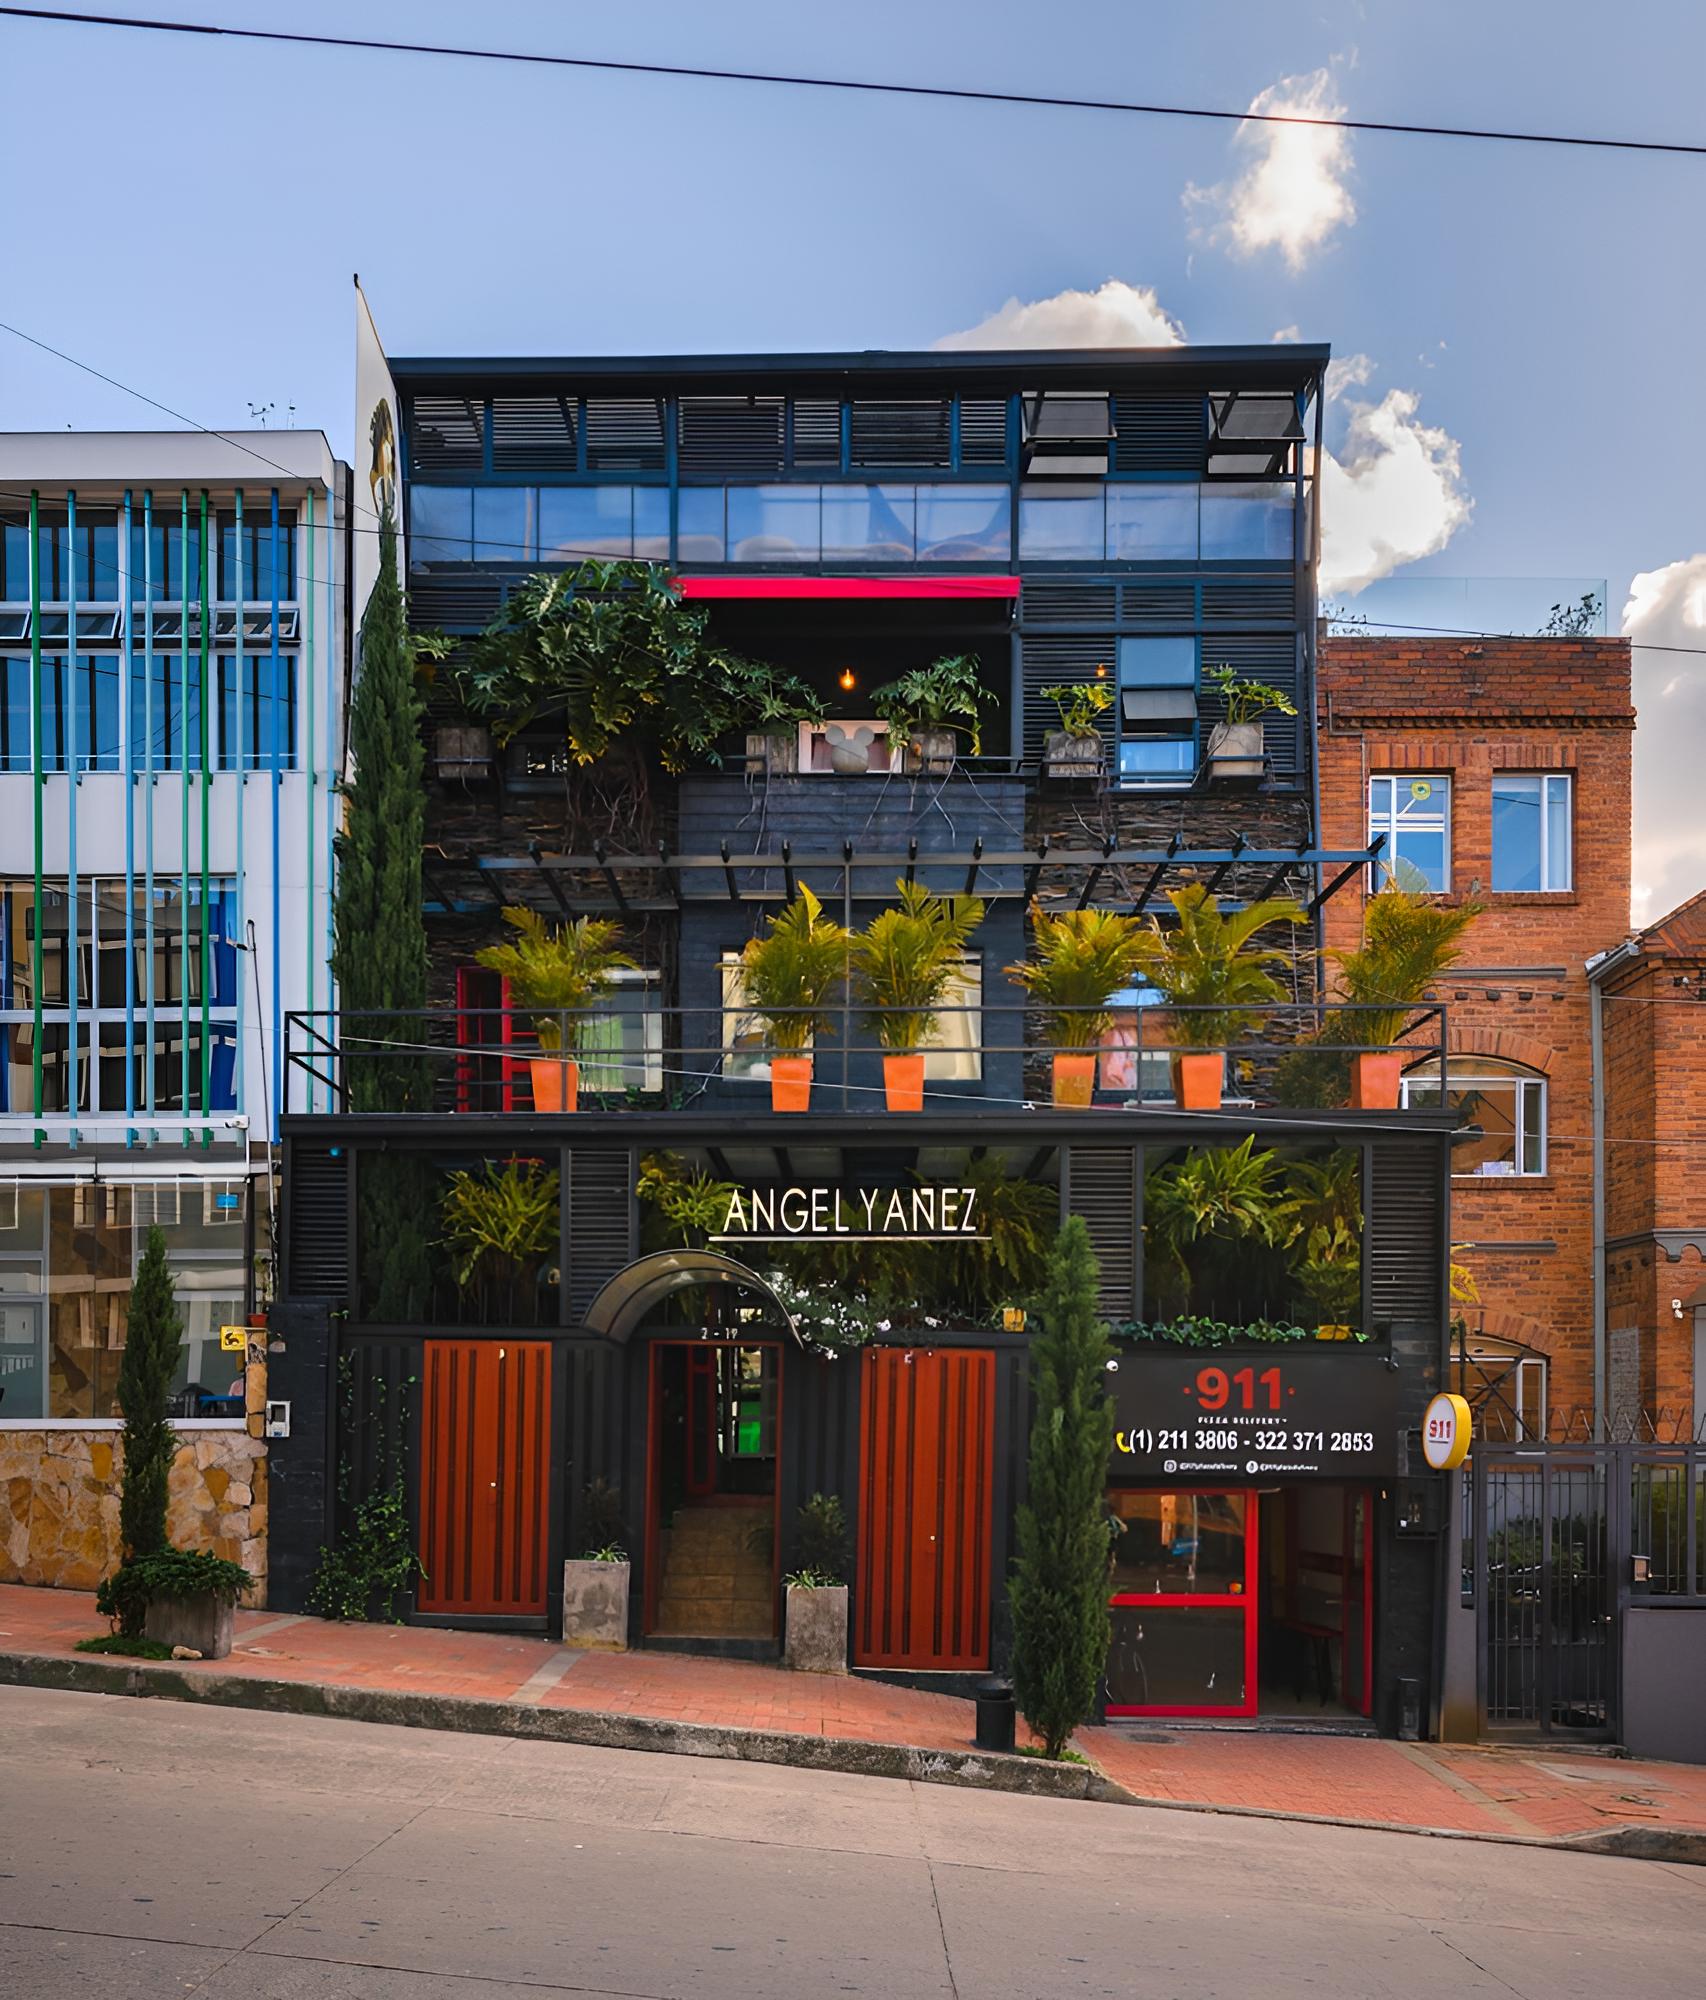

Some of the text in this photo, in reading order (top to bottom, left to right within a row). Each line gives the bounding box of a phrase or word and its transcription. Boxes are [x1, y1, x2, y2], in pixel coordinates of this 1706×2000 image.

[723, 1187, 850, 1233] ANGEL
[1129, 1428, 1154, 1454] (1)
[1157, 1429, 1189, 1450] 211
[1194, 1430, 1239, 1451] 3806
[1254, 1431, 1288, 1451] 322
[1292, 1431, 1324, 1452] 371
[1330, 1432, 1374, 1452] 2853
[1429, 1419, 1452, 1439] 911
